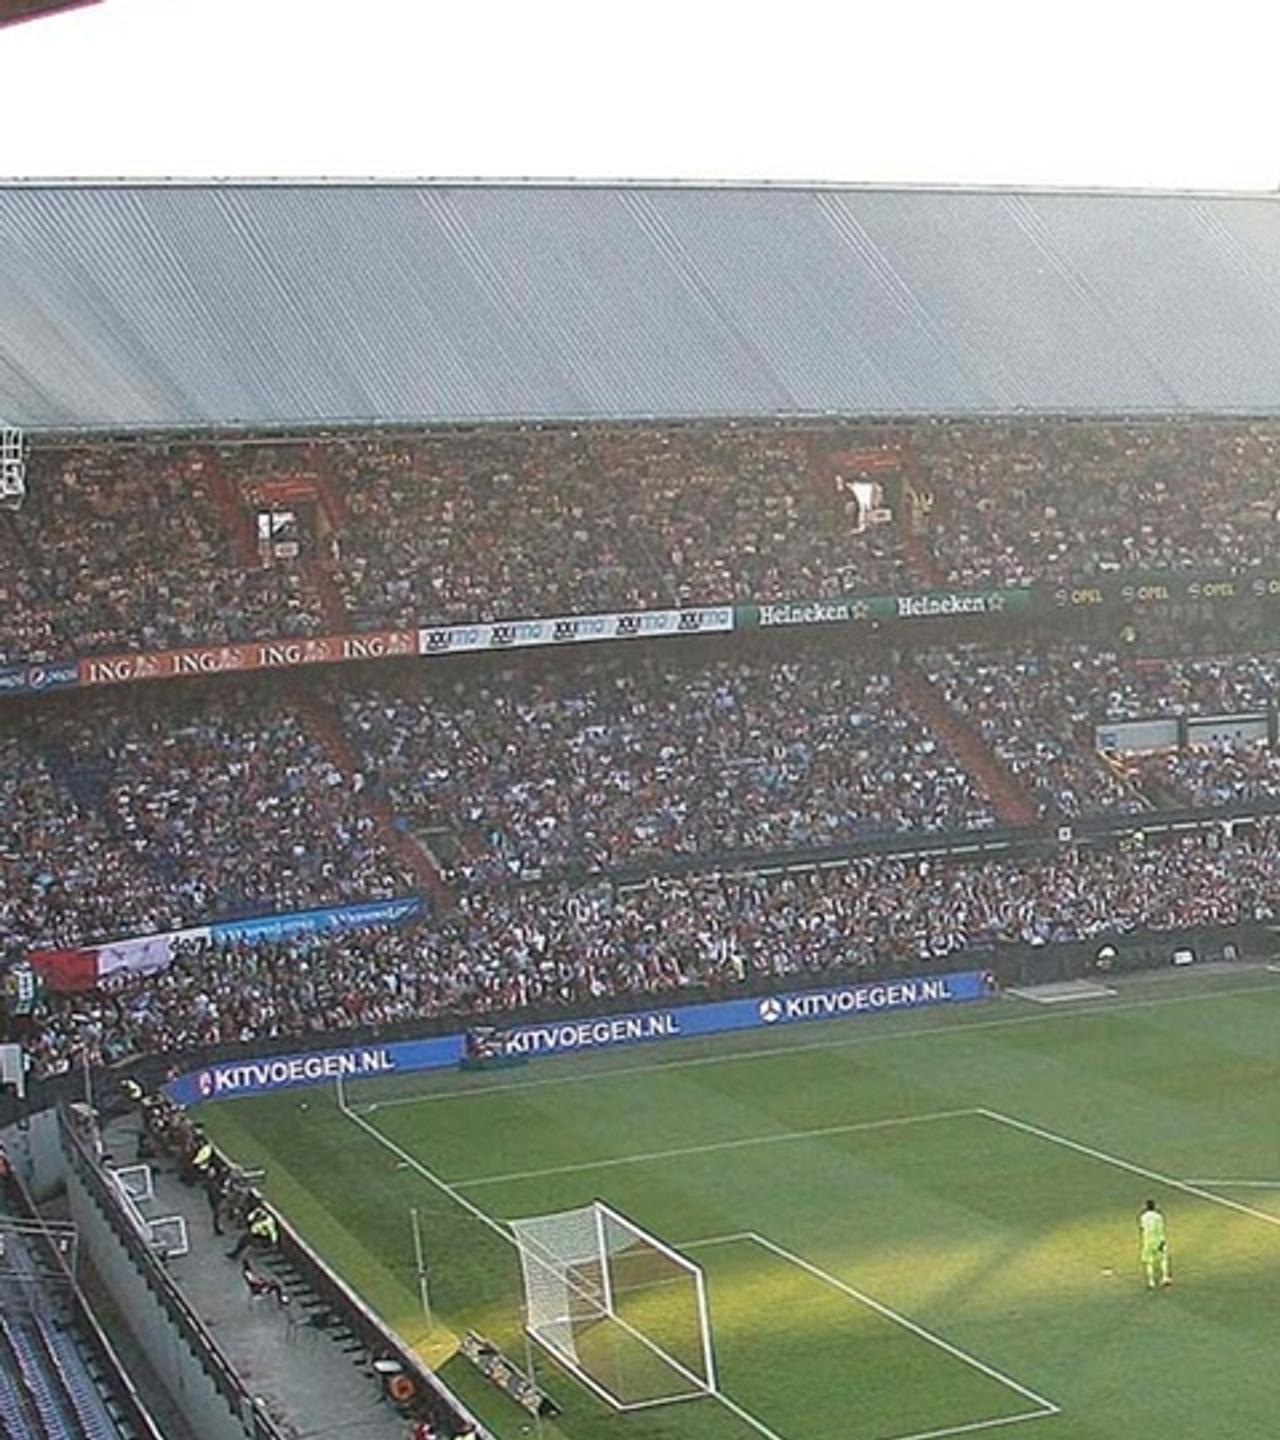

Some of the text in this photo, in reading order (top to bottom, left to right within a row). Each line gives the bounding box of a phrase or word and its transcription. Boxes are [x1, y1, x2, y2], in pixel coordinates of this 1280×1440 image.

[758, 605, 849, 626] Heineken
[898, 595, 986, 617] Heineken
[260, 645, 300, 665] ING
[343, 637, 383, 658] ING
[90, 660, 131, 682] ING
[173, 652, 217, 673] ING
[786, 980, 952, 1019] KITVOEGEN.NL
[505, 1012, 681, 1055] KITVOEGEN.NL
[214, 1050, 395, 1090] KITVOEGEN.NL
